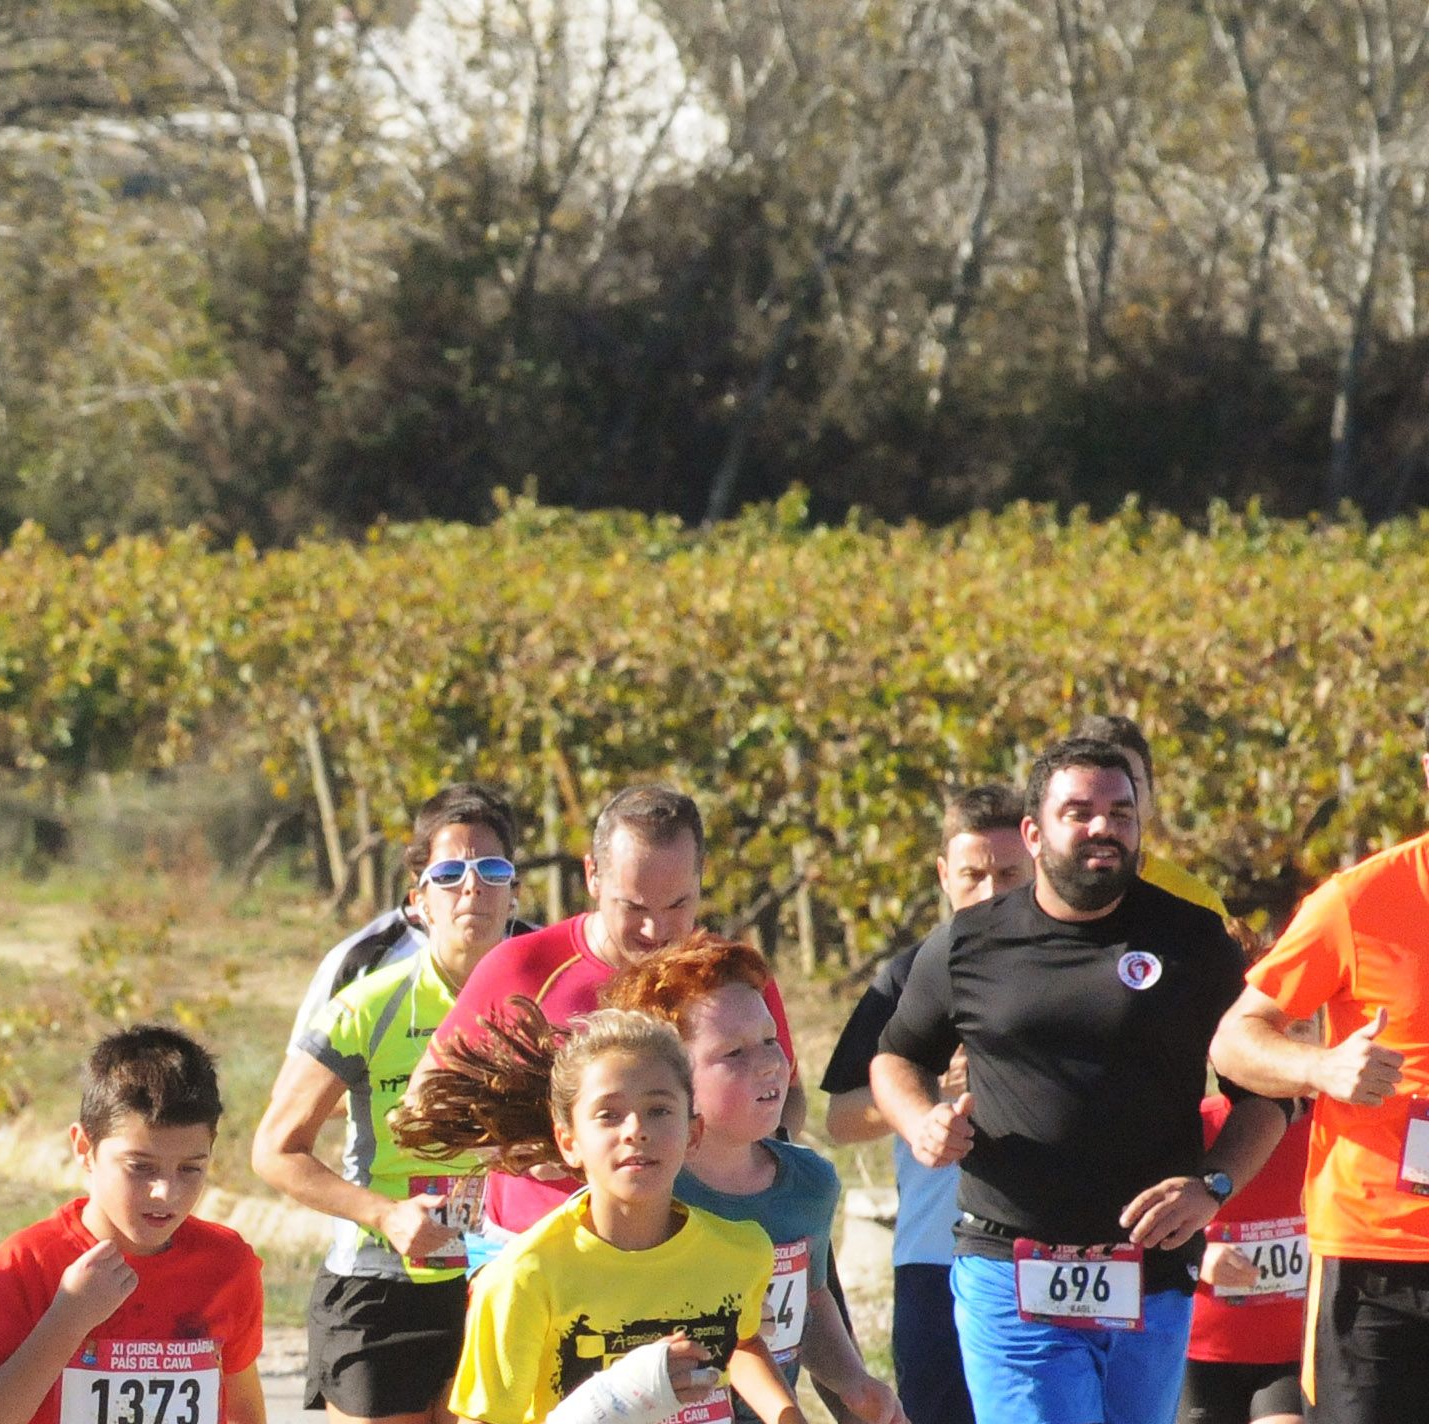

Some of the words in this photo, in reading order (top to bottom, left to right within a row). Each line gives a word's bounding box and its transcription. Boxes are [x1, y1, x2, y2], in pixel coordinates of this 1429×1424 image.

[1049, 1266, 1111, 1302] 696
[112, 1343, 124, 1354] XI
[127, 1342, 164, 1355] CURSA
[111, 1355, 137, 1369] PAÍS
[139, 1357, 160, 1369] DEL
[163, 1357, 192, 1369] CAVA
[683, 1408, 709, 1423] CAVA
